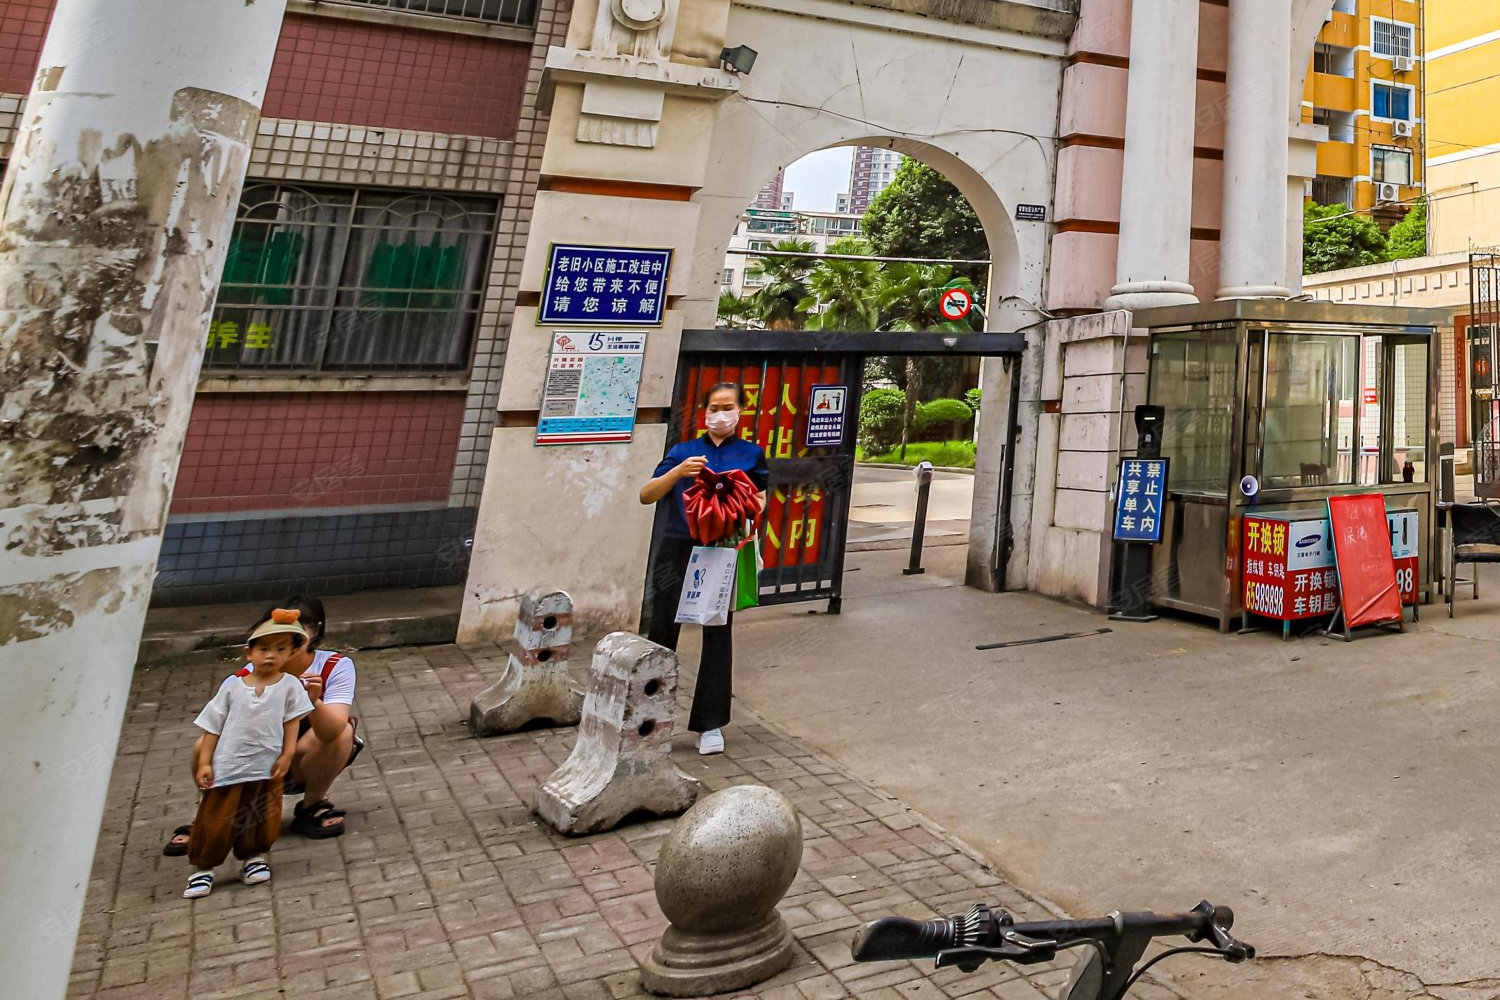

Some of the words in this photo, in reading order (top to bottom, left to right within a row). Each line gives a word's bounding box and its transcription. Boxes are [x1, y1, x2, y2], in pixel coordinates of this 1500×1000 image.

[557, 256, 662, 275] 老旧小区施工改造中
[555, 276, 659, 295] 给您带来不便
[553, 296, 656, 314] 请您谅解
[1121, 462, 1142, 531] 共享单车
[1140, 463, 1161, 532] 禁止入内
[1248, 521, 1286, 557] 开换锁
[1297, 536, 1320, 547] SAMSUNG
[1297, 550, 1321, 558] 三星电子门锁
[1246, 558, 1264, 576] 指纹锁
[1267, 561, 1286, 580] 车钥匙
[1294, 571, 1337, 592] 开换锁
[1246, 580, 1285, 617] 65989898
[1293, 593, 1336, 616] 车钥匙
